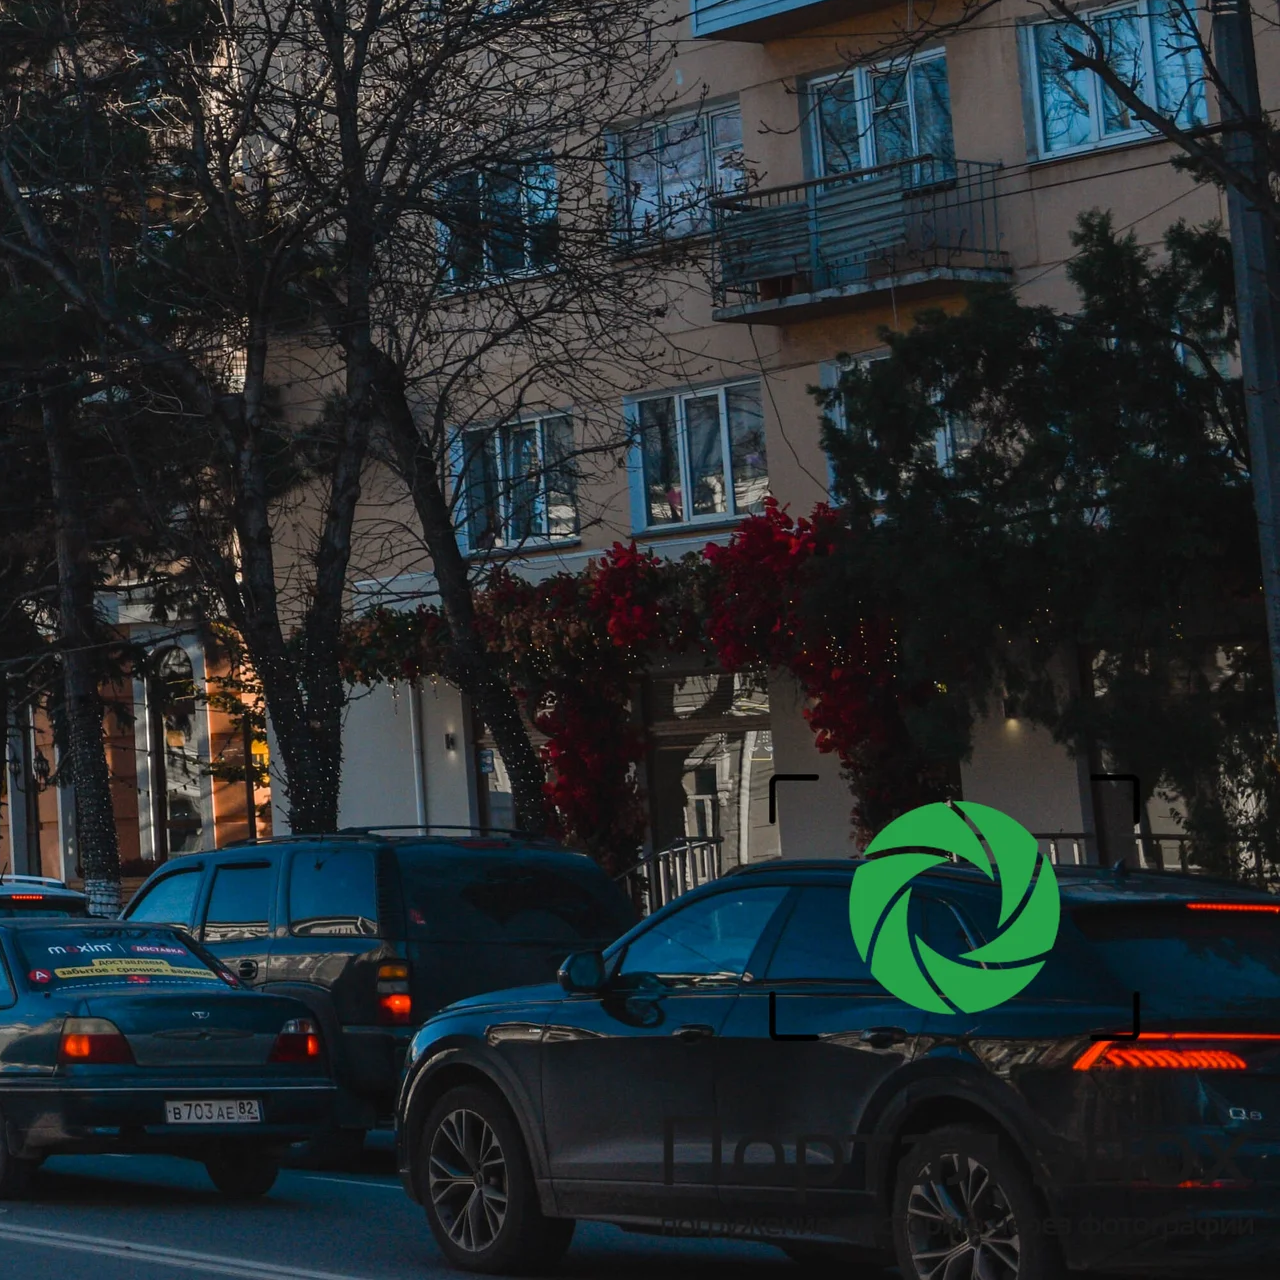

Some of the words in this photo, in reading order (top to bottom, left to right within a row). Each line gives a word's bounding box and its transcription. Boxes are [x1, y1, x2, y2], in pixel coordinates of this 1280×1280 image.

[48, 943, 112, 955] maxim
[59, 967, 109, 976] забытое
[1228, 1106, 1263, 1121] Q8
